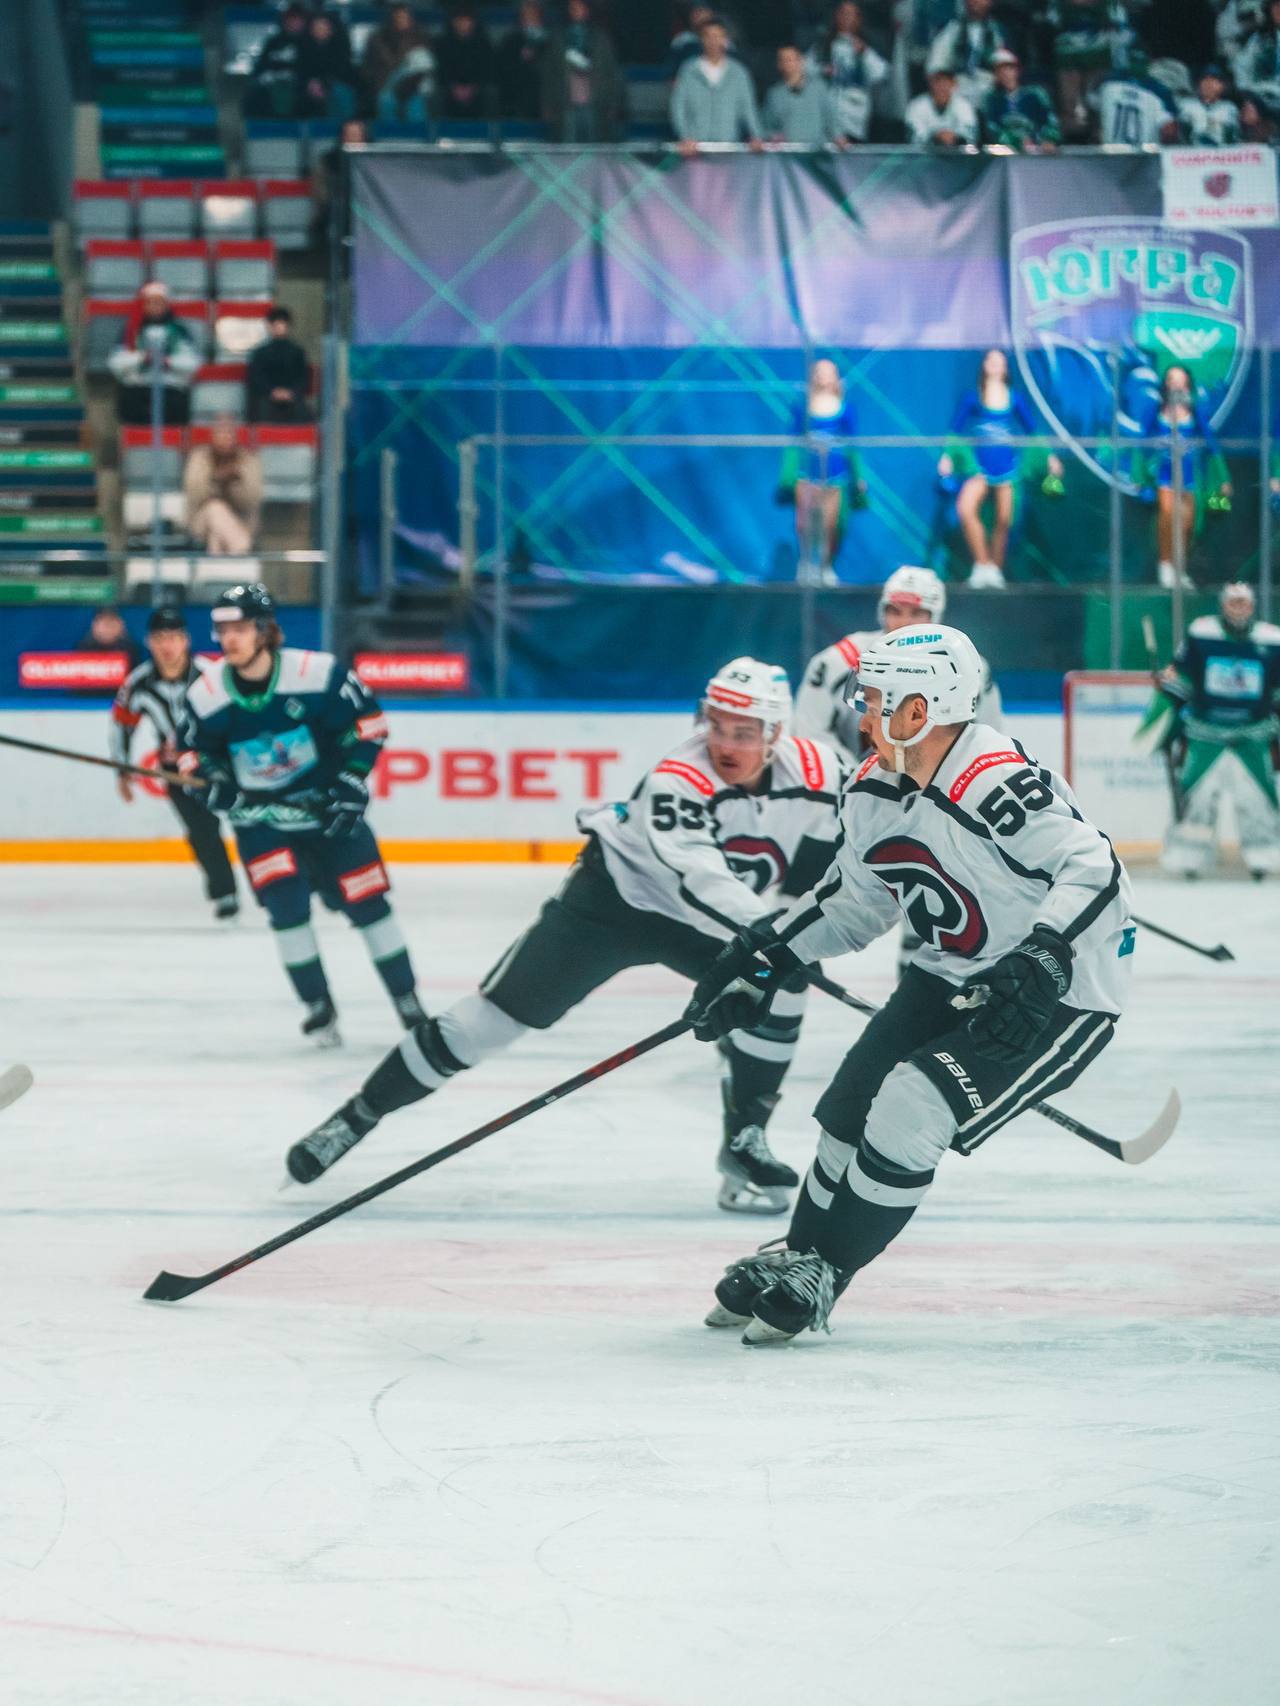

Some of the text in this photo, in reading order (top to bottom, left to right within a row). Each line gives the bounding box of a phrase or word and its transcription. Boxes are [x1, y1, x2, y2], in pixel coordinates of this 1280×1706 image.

[896, 634, 943, 647] СИБУР
[953, 752, 1018, 794] OLIMPBET
[651, 793, 705, 831] 53
[976, 768, 1054, 837] 55
